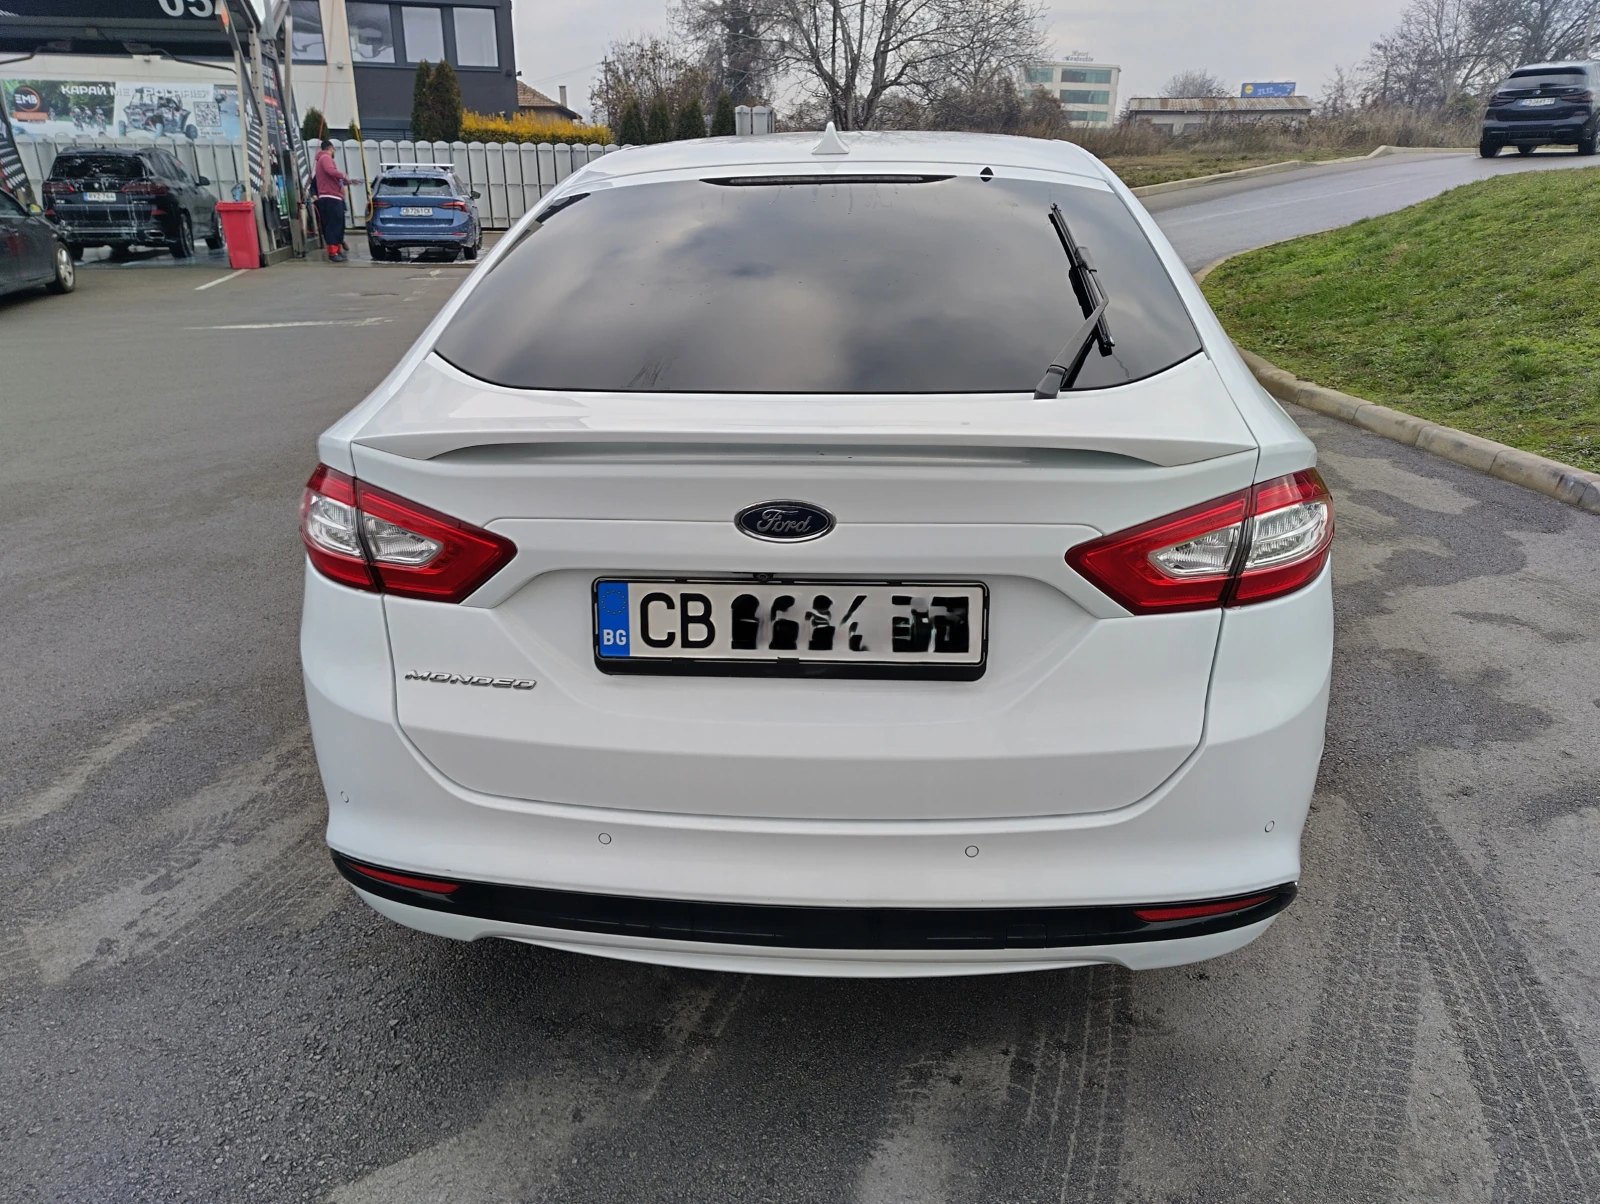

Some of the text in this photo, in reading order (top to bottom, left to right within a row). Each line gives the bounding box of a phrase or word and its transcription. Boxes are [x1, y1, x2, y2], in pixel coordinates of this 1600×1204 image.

[61, 84, 107, 96] КАРАЙ
[756, 508, 812, 533] Ford
[639, 592, 716, 649] CB
[602, 629, 627, 646] BG
[404, 669, 537, 691] MONDEO
